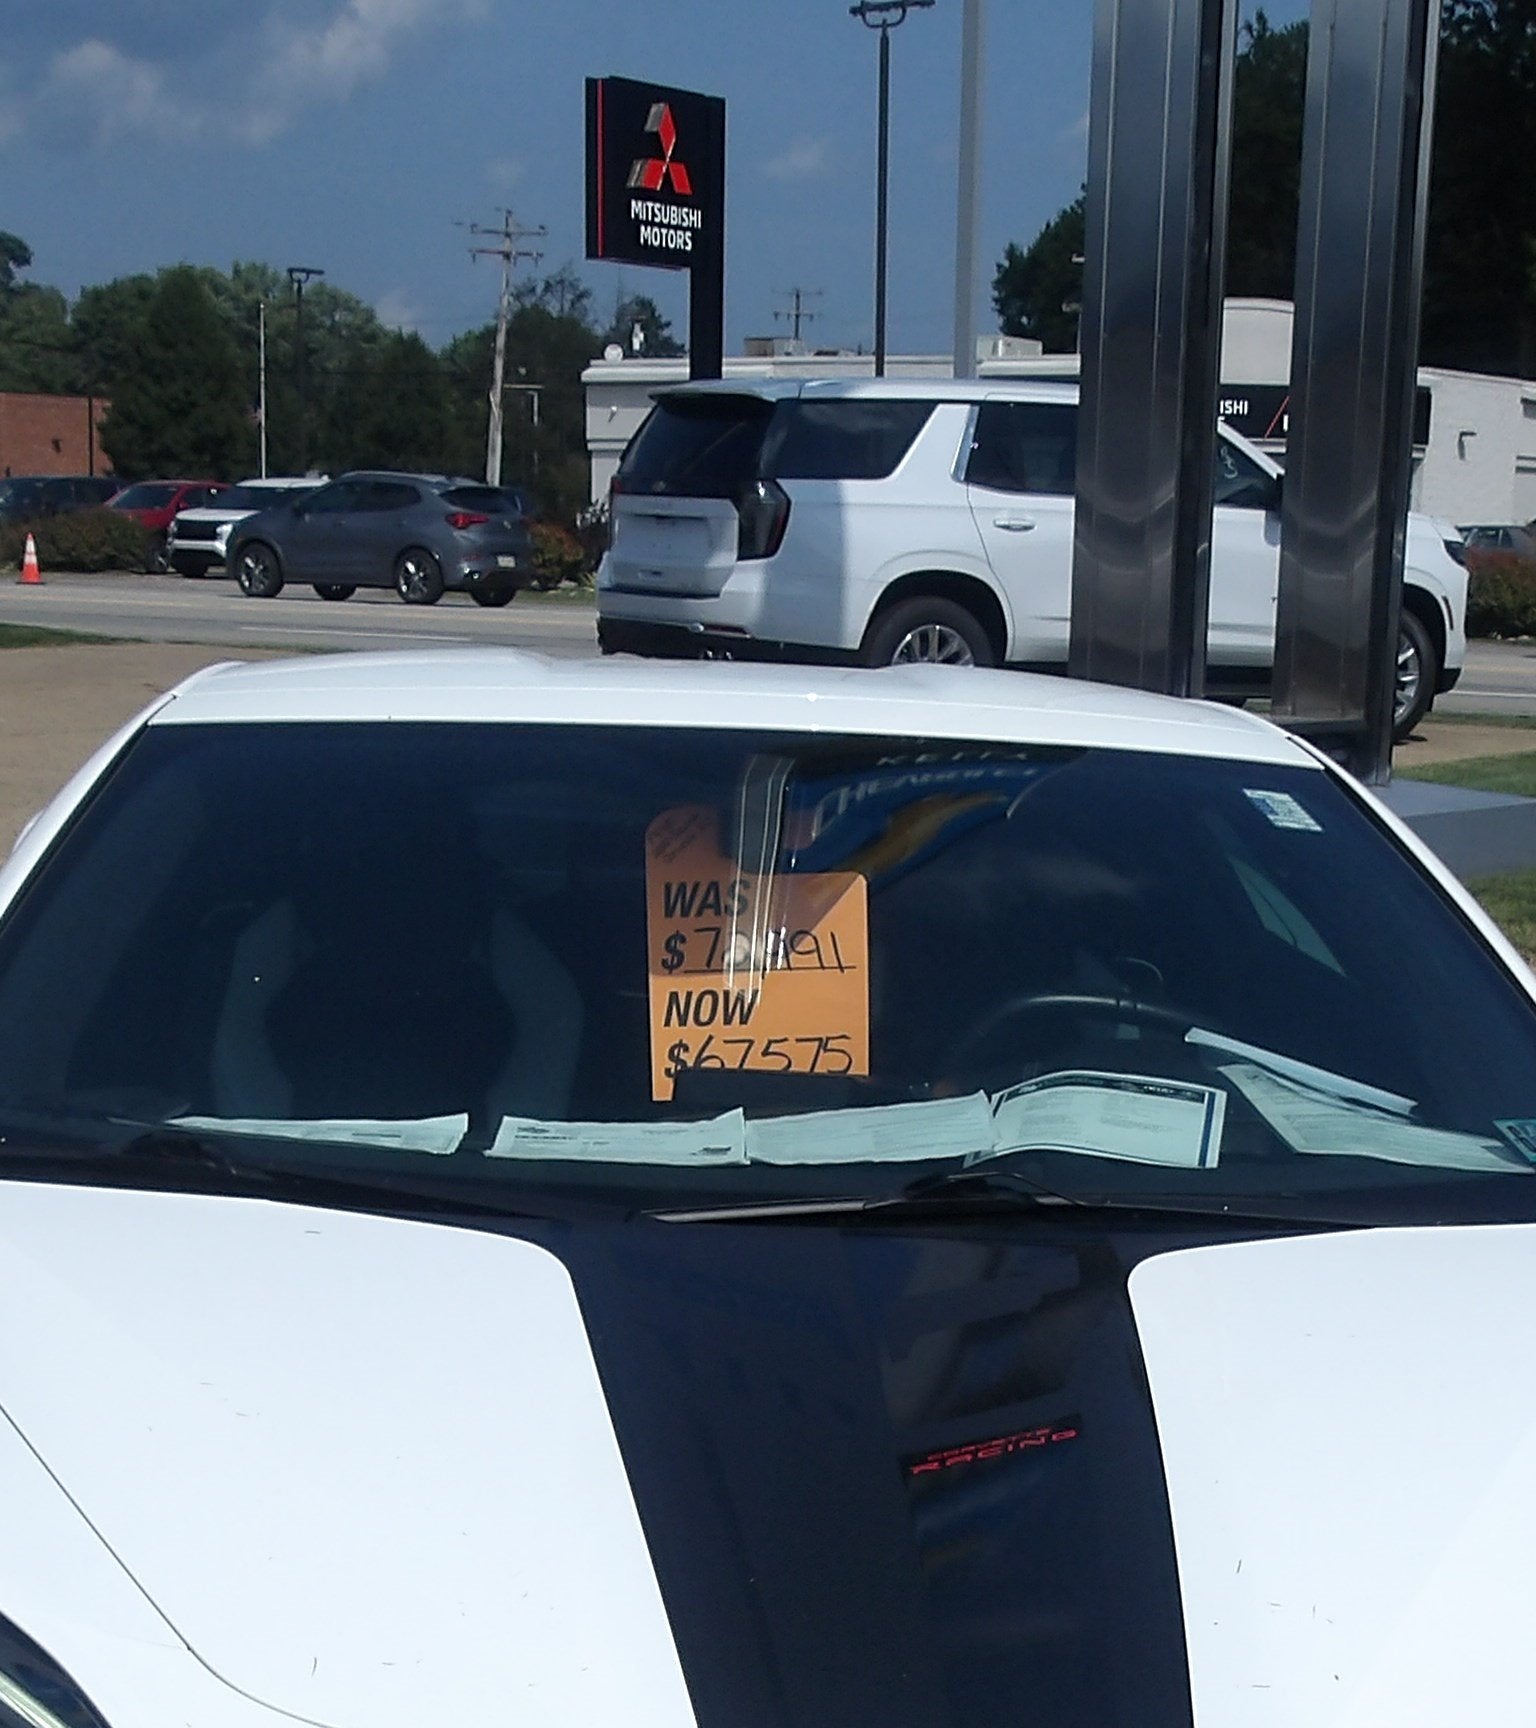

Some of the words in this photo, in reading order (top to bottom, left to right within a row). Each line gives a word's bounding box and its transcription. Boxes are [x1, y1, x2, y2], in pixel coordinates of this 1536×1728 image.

[630, 199, 702, 228] MITSUBISHI
[639, 223, 693, 252] MOTORS
[662, 880, 751, 918] WAS
[663, 988, 759, 1028] NOW
